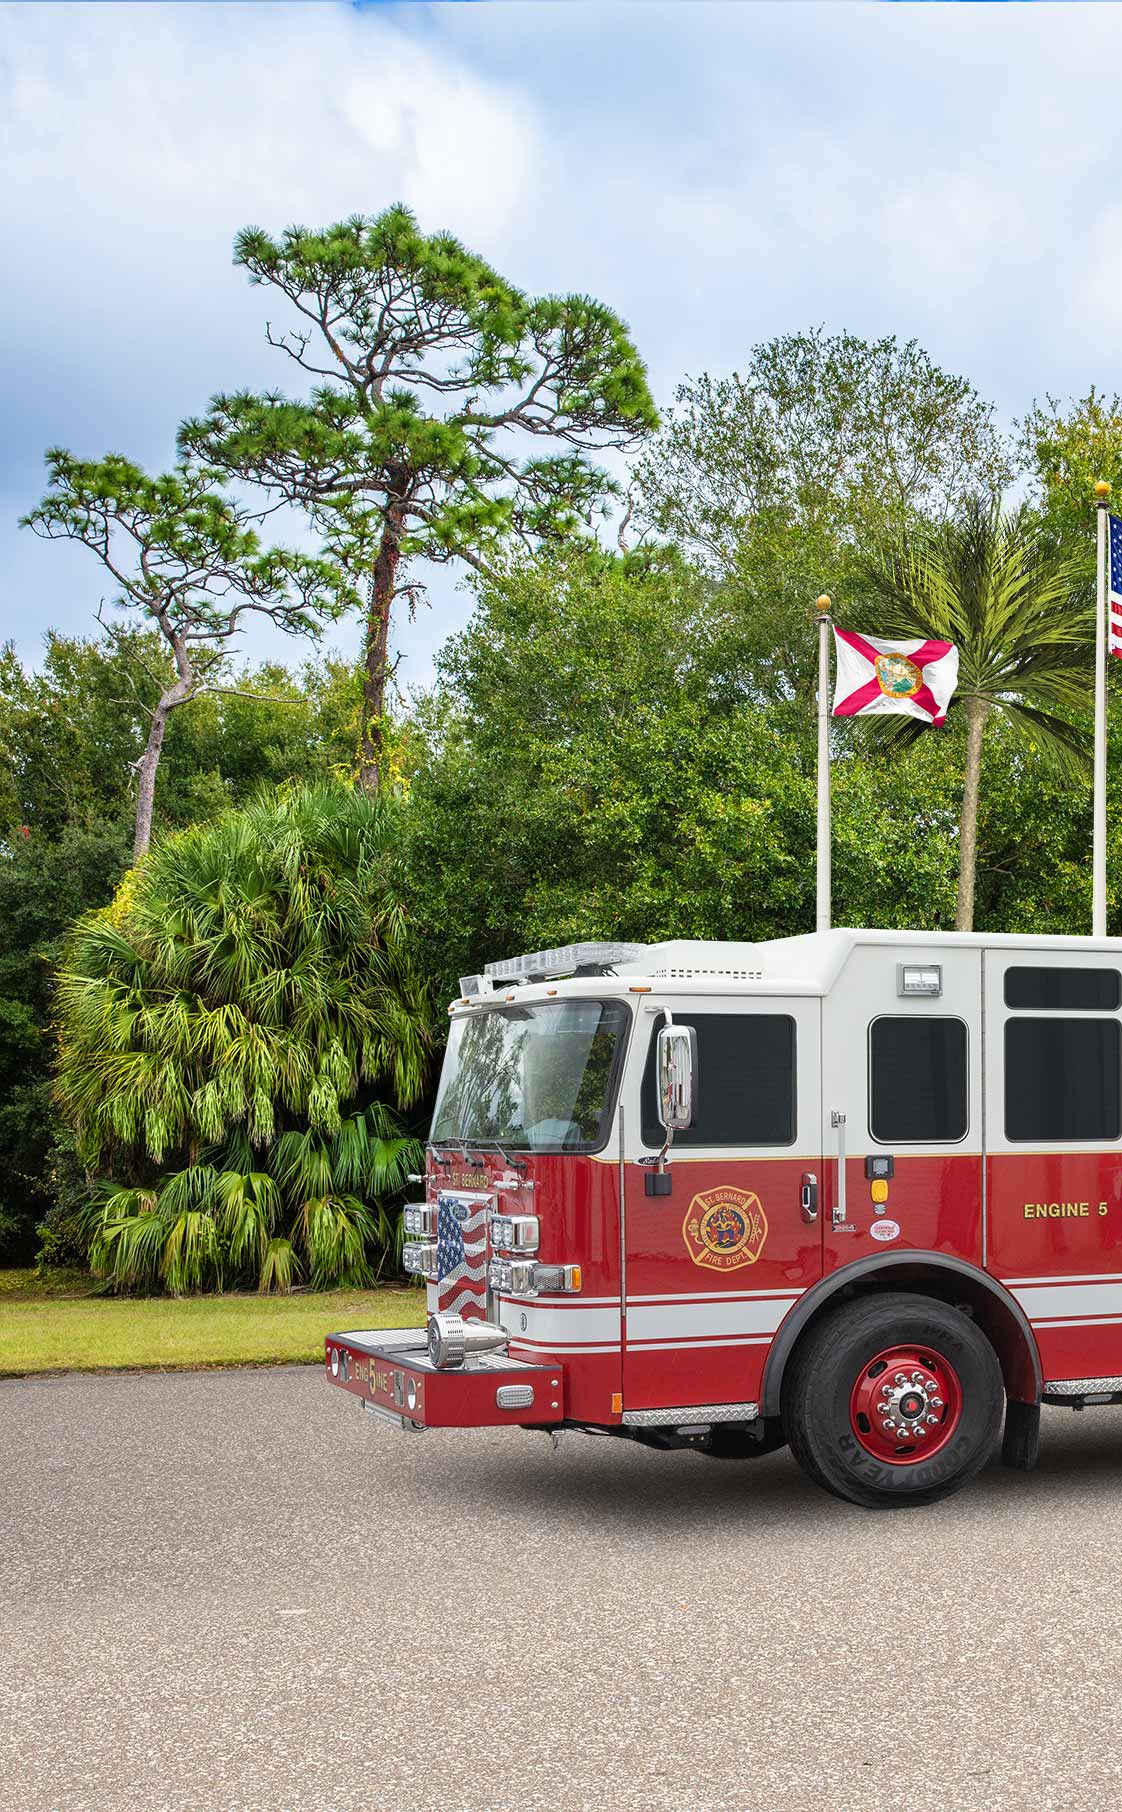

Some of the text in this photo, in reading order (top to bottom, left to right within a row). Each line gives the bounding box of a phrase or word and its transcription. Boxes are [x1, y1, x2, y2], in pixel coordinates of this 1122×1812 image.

[461, 1172, 489, 1189] BERNARD
[715, 1192, 746, 1205] BERNARD
[1023, 1201, 1108, 1219] ENGINE 5
[704, 1252, 748, 1265] FIRE DEPT.
